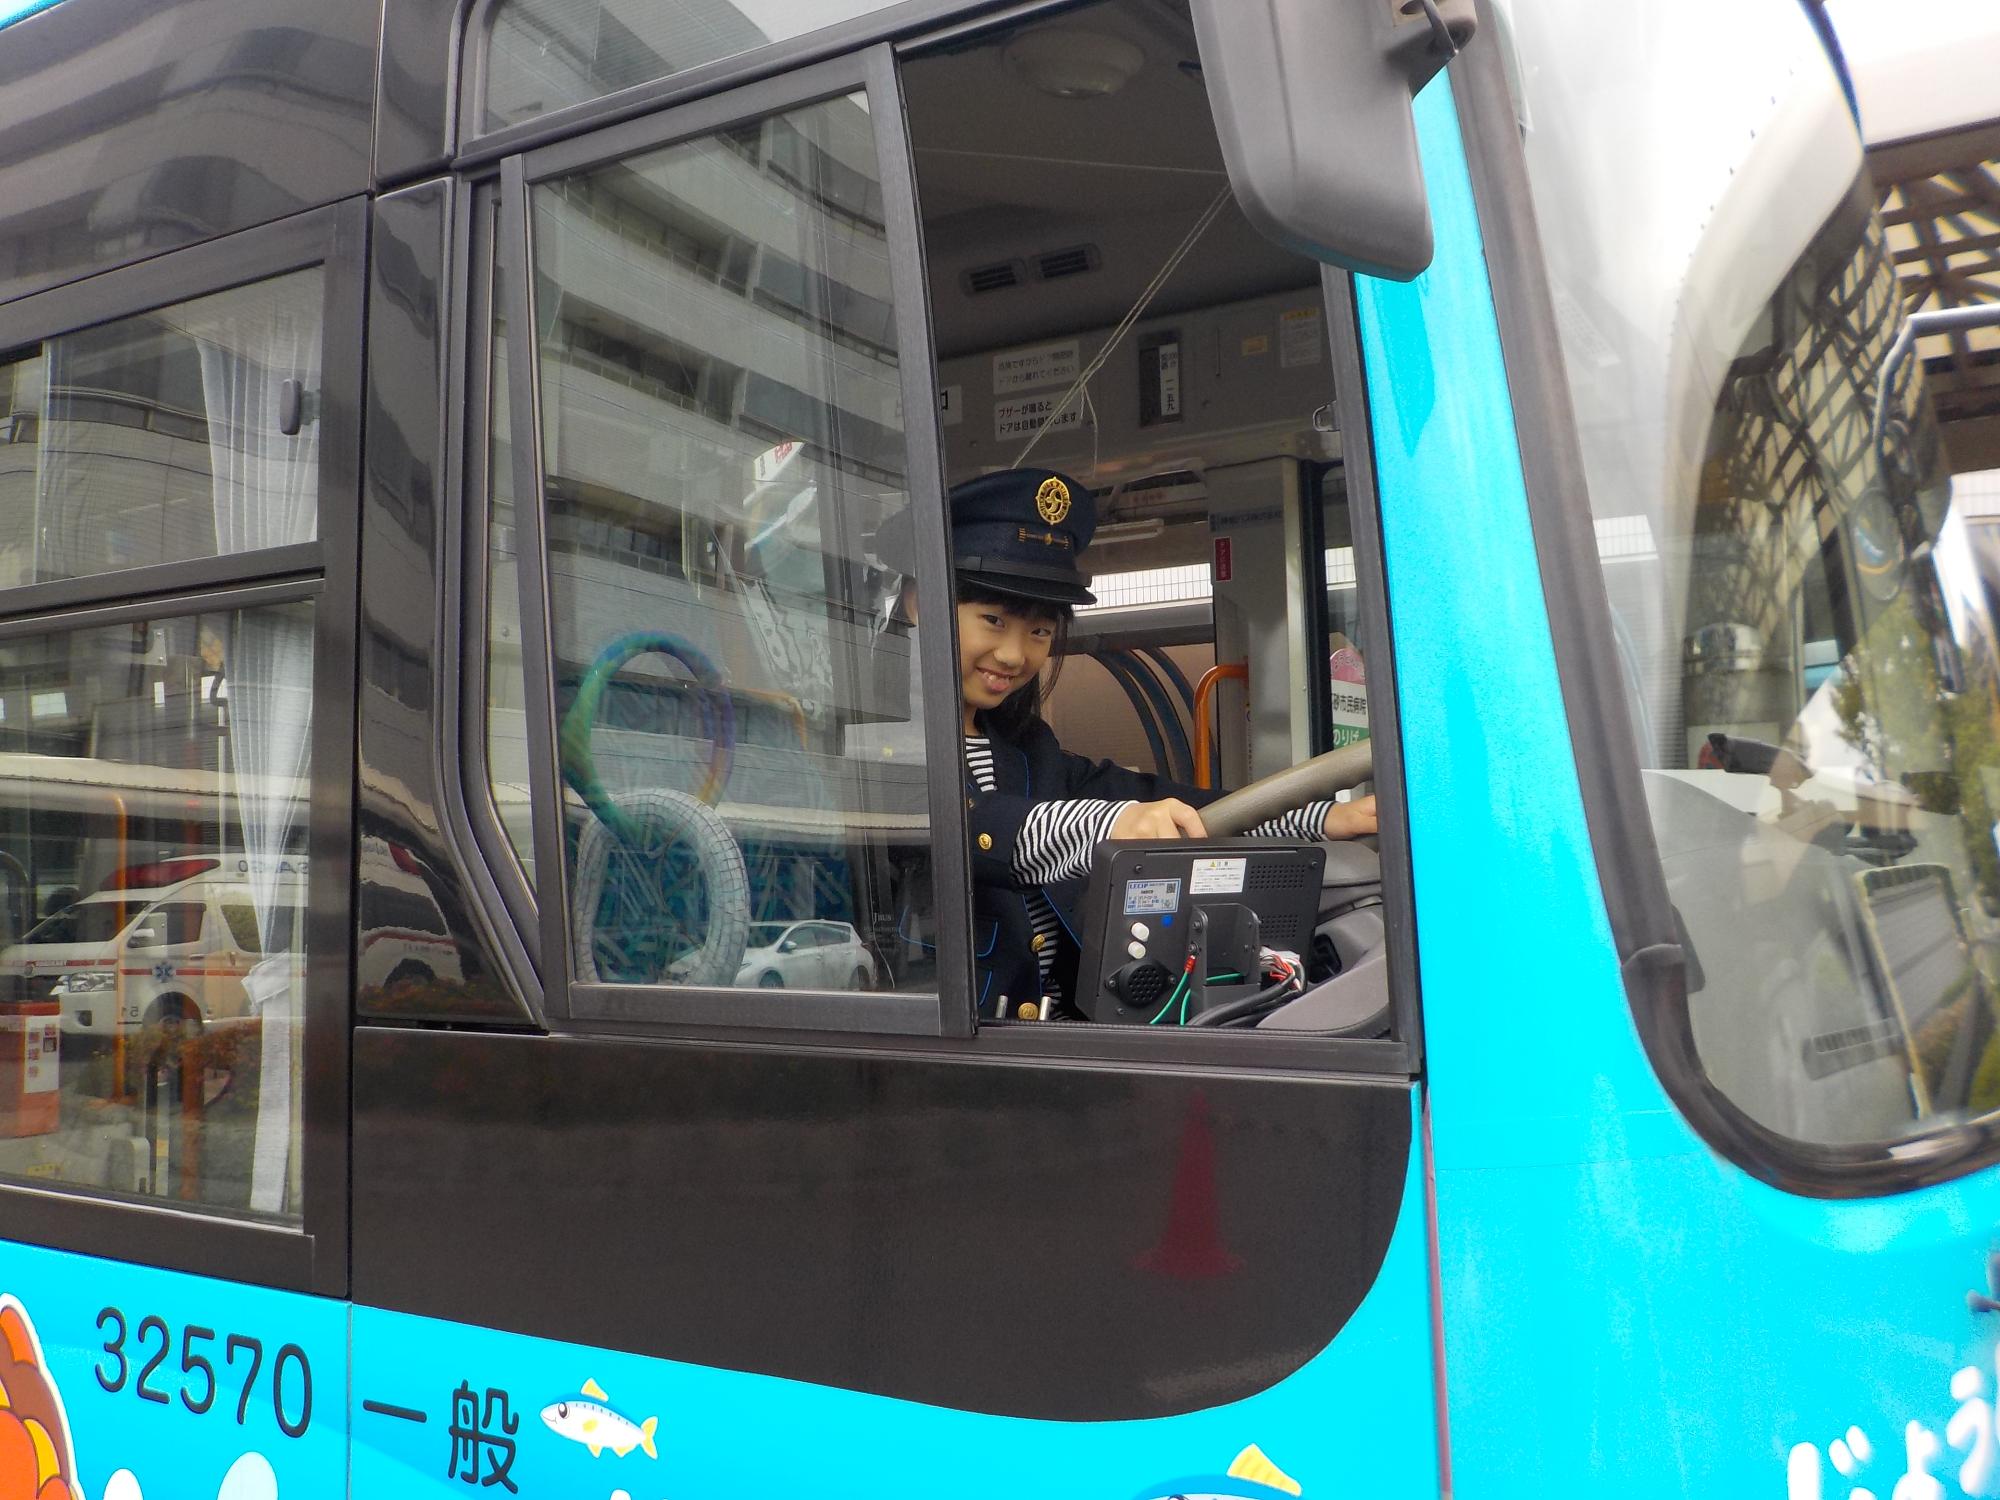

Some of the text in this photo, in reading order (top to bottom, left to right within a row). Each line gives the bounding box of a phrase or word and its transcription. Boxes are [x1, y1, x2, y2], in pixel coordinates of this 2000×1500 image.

[998, 401, 1053, 418] ブザーが鳴ると
[95, 1306, 313, 1439] 32570
[1787, 1342, 2000, 1500] じょう
[362, 1378, 520, 1496] 一般
